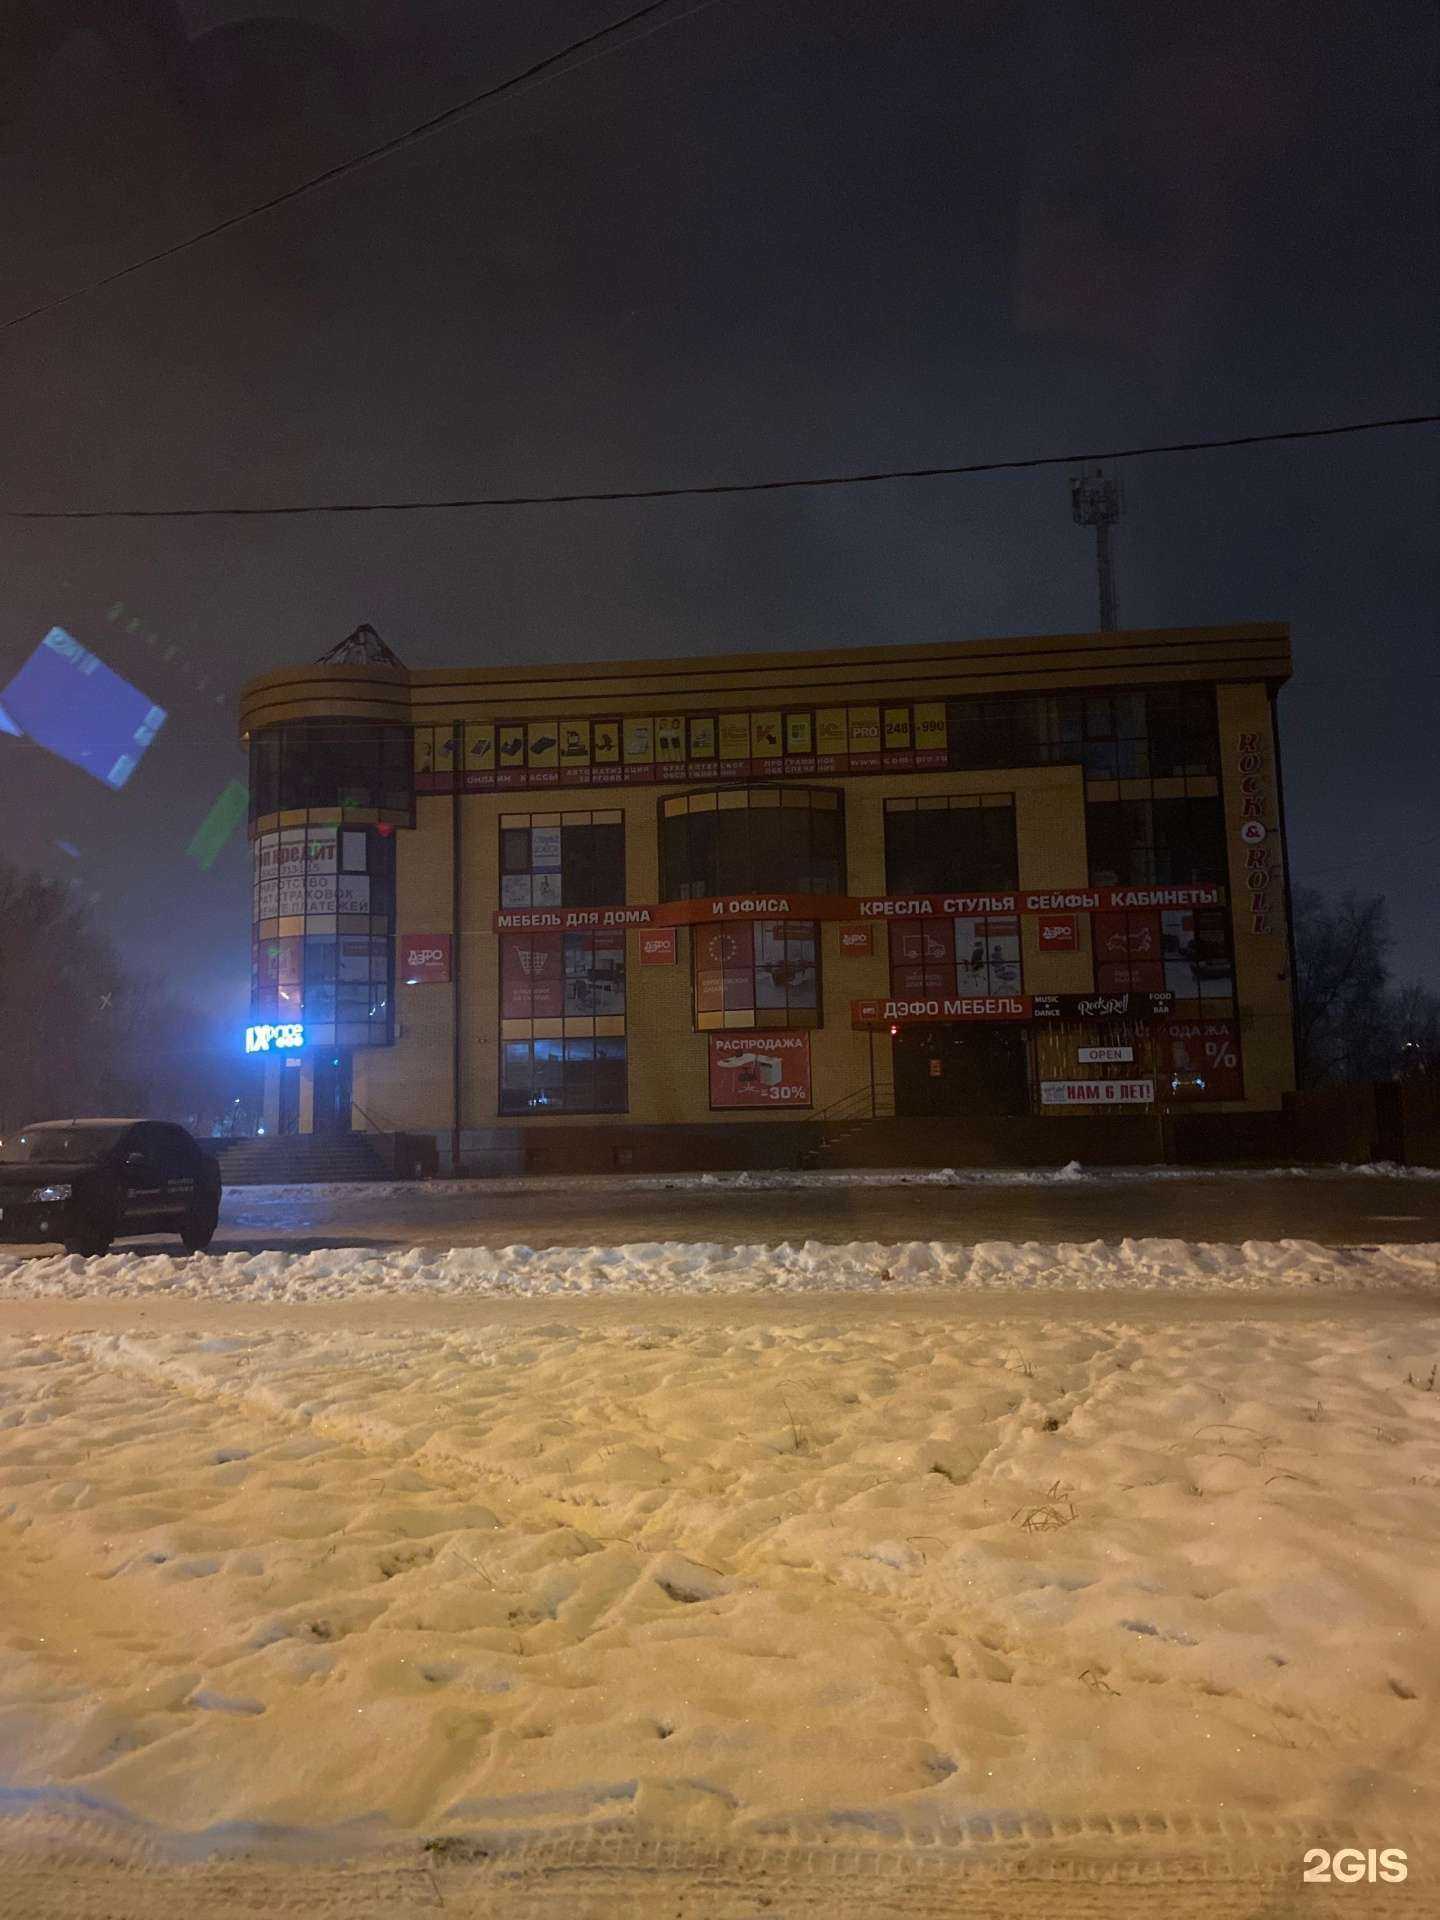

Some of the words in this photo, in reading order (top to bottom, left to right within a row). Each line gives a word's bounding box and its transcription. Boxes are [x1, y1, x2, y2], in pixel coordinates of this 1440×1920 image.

[852, 726, 878, 739] PRO
[859, 899, 934, 916] КРЕСЛА
[943, 896, 1016, 913] СТУЛЬЯ
[1026, 890, 1100, 910] СЕЙФЫ
[1111, 889, 1218, 907] КАБИНЕТЫ
[496, 913, 562, 928] МЕБЕЛЬ
[565, 911, 599, 926] ДЛЯ
[602, 909, 652, 926] ДОМА
[711, 901, 724, 914] И
[728, 899, 790, 914] ОФИСА
[1034, 995, 1060, 1004] MUSIC
[1149, 993, 1172, 1001] FOOD
[883, 1001, 939, 1019] ДЭФО
[943, 998, 1023, 1015] МЕБЕЛЬ
[1034, 1008, 1061, 1017] DANCE
[1153, 1006, 1170, 1015] BAR
[715, 1038, 804, 1051] РАСПРОДАЖА
[1088, 1047, 1122, 1060] OPEN
[1066, 1084, 1099, 1100] НАМ
[1105, 1085, 1115, 1099] 6
[1120, 1084, 1150, 1100] ЛЕТ!
